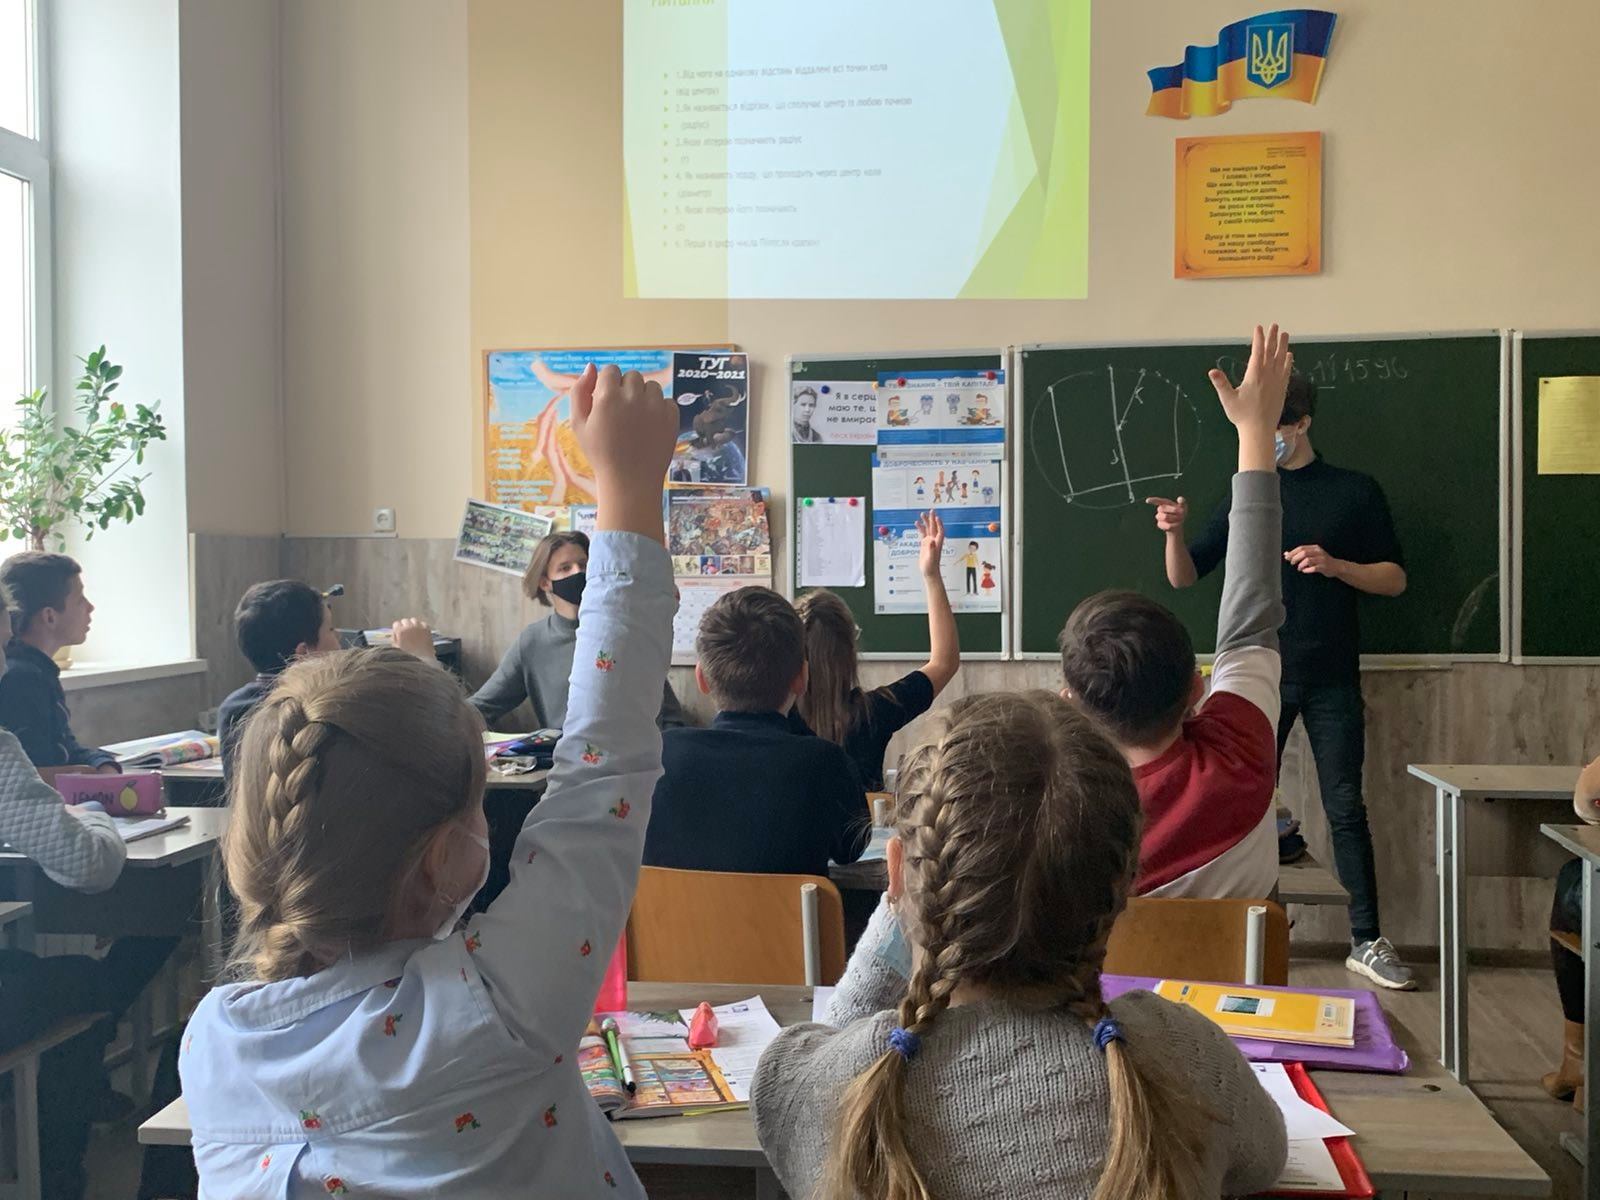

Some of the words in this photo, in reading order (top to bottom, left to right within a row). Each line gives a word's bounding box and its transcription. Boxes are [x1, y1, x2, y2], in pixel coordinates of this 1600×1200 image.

[832, 65, 844, 74] всі
[846, 64, 868, 72] точки
[836, 392, 841, 400] Я
[851, 394, 876, 402] серц
